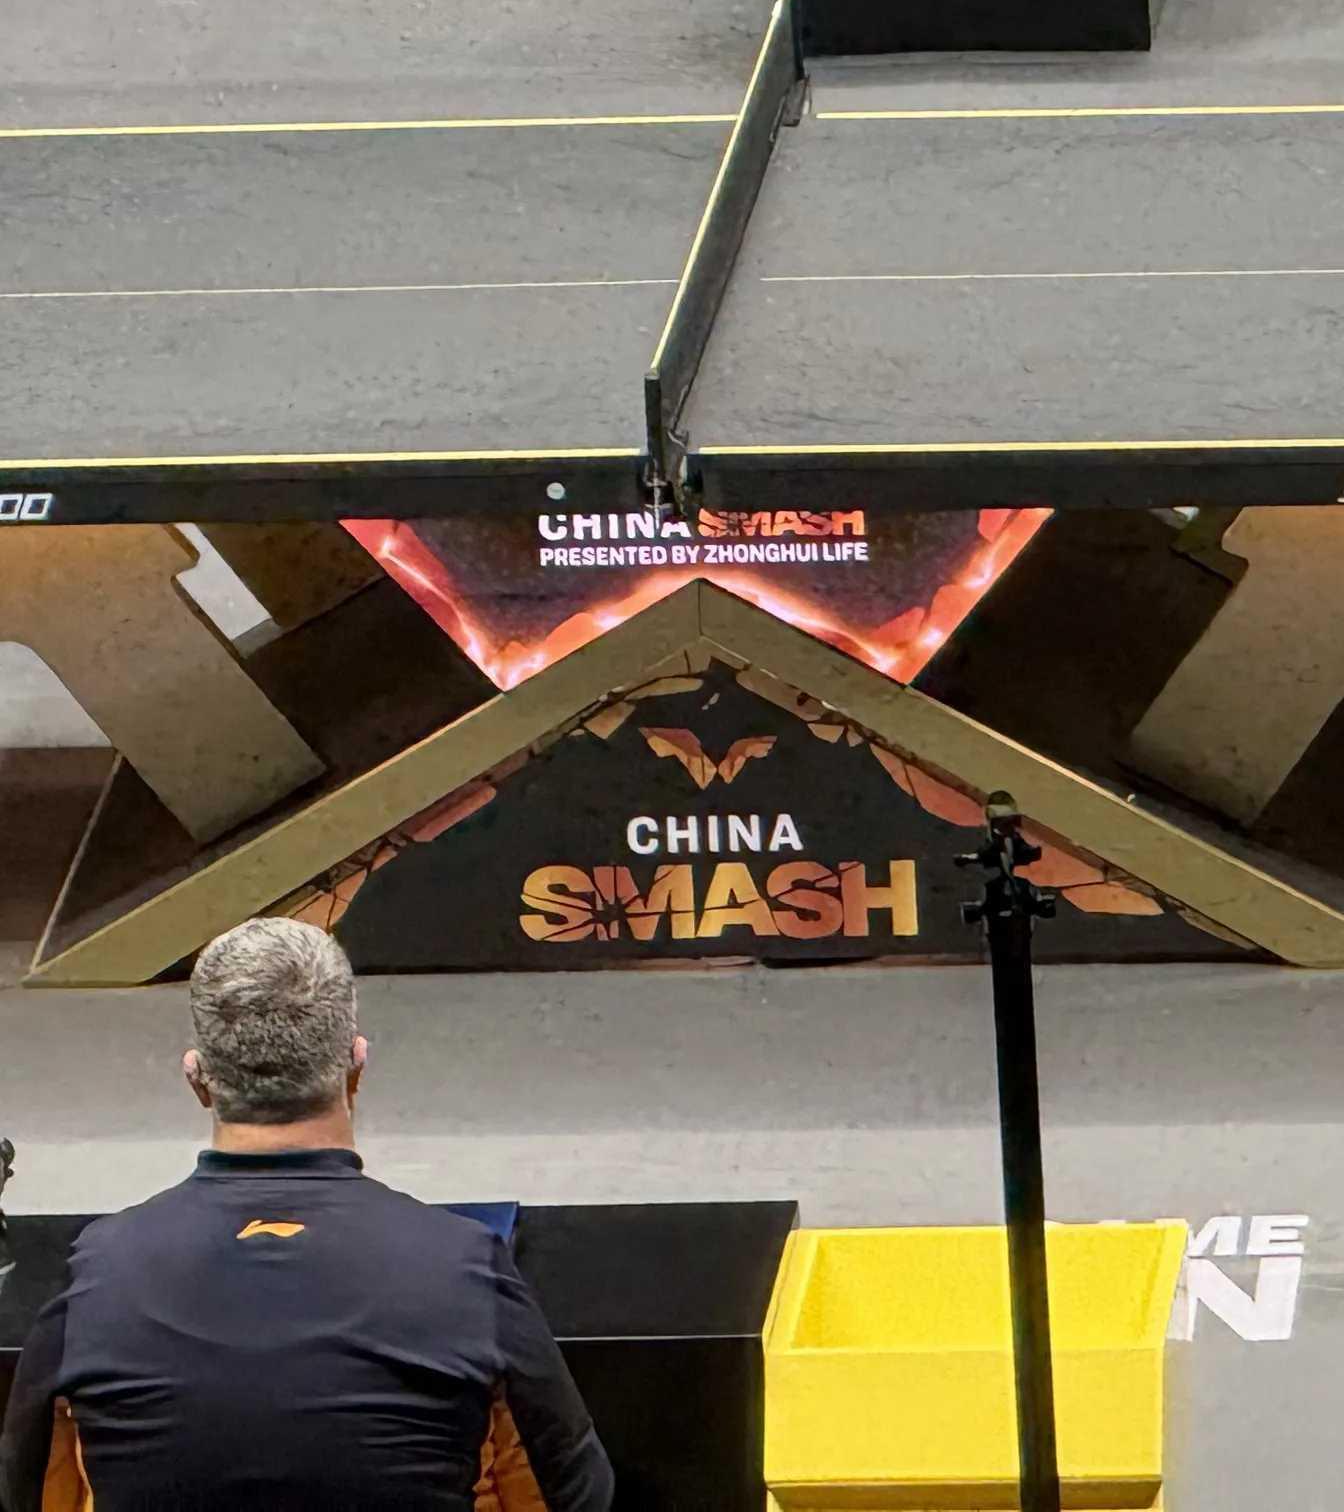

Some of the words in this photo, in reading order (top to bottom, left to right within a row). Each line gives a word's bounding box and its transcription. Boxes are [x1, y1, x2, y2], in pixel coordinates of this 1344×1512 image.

[538, 509, 691, 541] CHINA
[698, 508, 866, 539] SMASH
[539, 545, 667, 567] PRESENTED
[671, 544, 700, 565] BY
[703, 543, 819, 565] ZHONGHUI
[822, 542, 869, 562] LIFE
[627, 813, 803, 855] CHINA
[519, 859, 918, 942] SMASH
